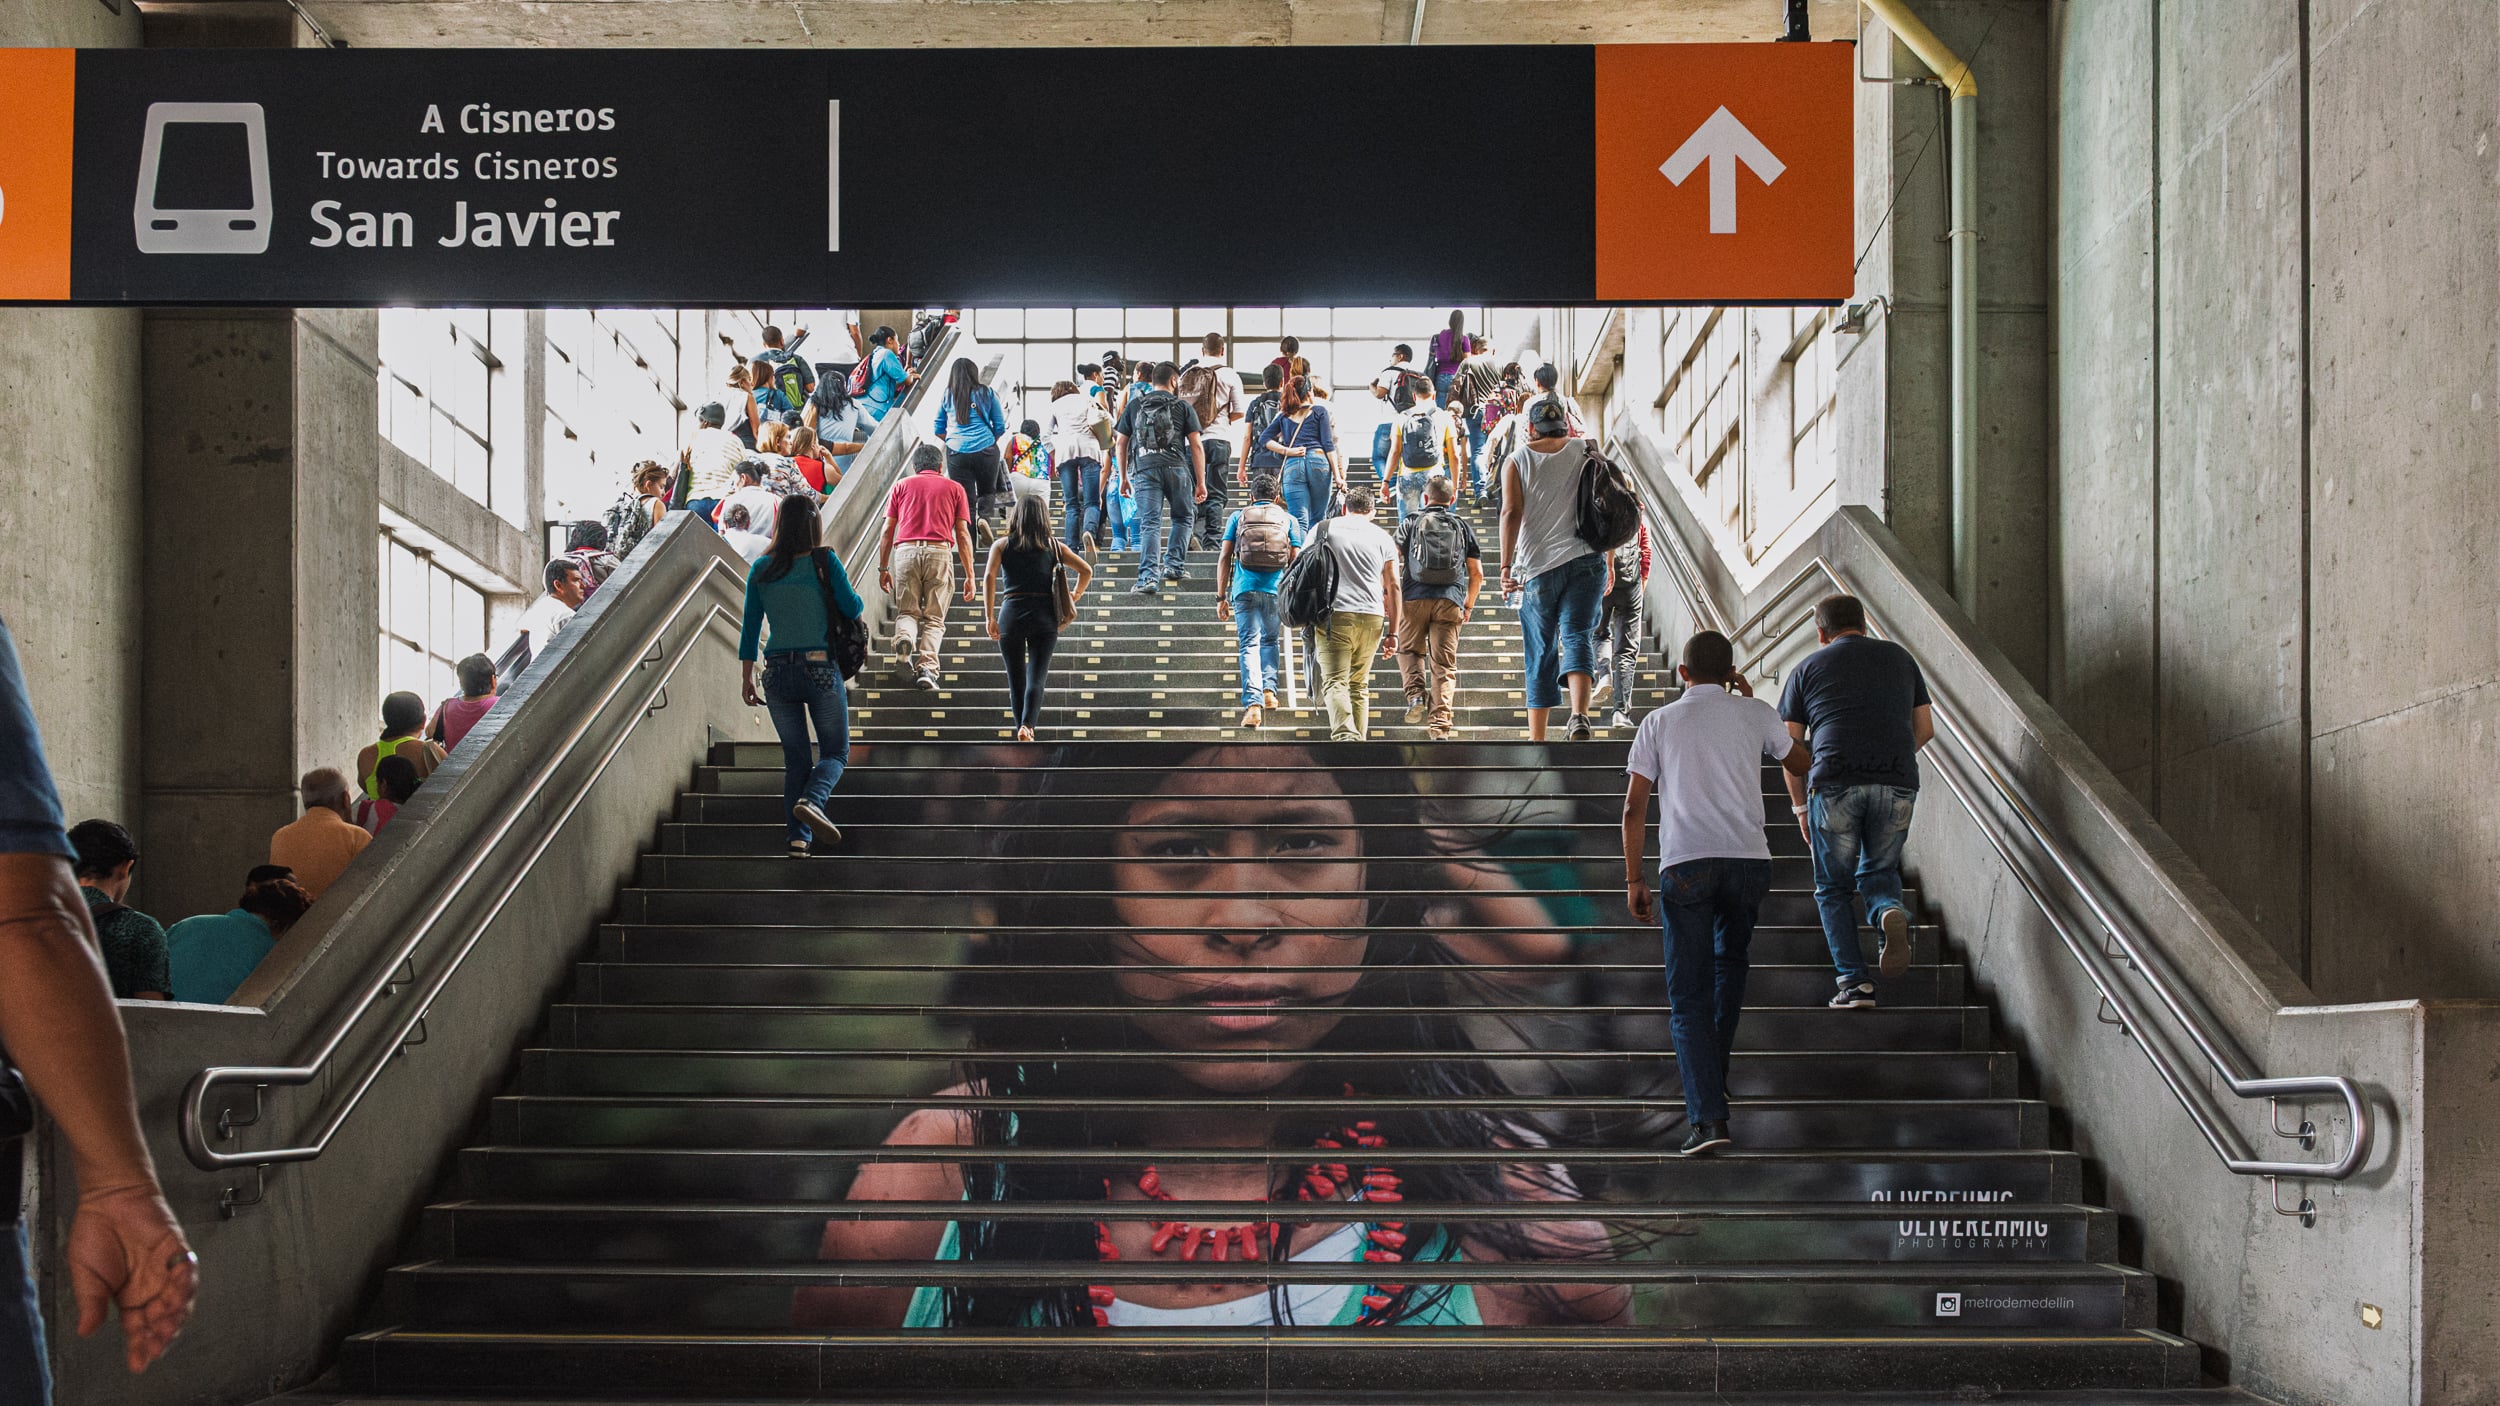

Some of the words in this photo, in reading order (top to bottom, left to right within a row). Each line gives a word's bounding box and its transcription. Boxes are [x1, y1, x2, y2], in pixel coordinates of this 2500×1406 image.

[420, 104, 445, 133] A
[460, 103, 616, 134] Cisneros
[316, 151, 460, 180] Towards
[474, 151, 618, 180] Cisneros
[310, 199, 414, 248] San
[438, 198, 621, 248] Javier
[1898, 1238, 2047, 1249] PHOTOGRAPHY
[1964, 1297, 2074, 1309] metrodemedellin
